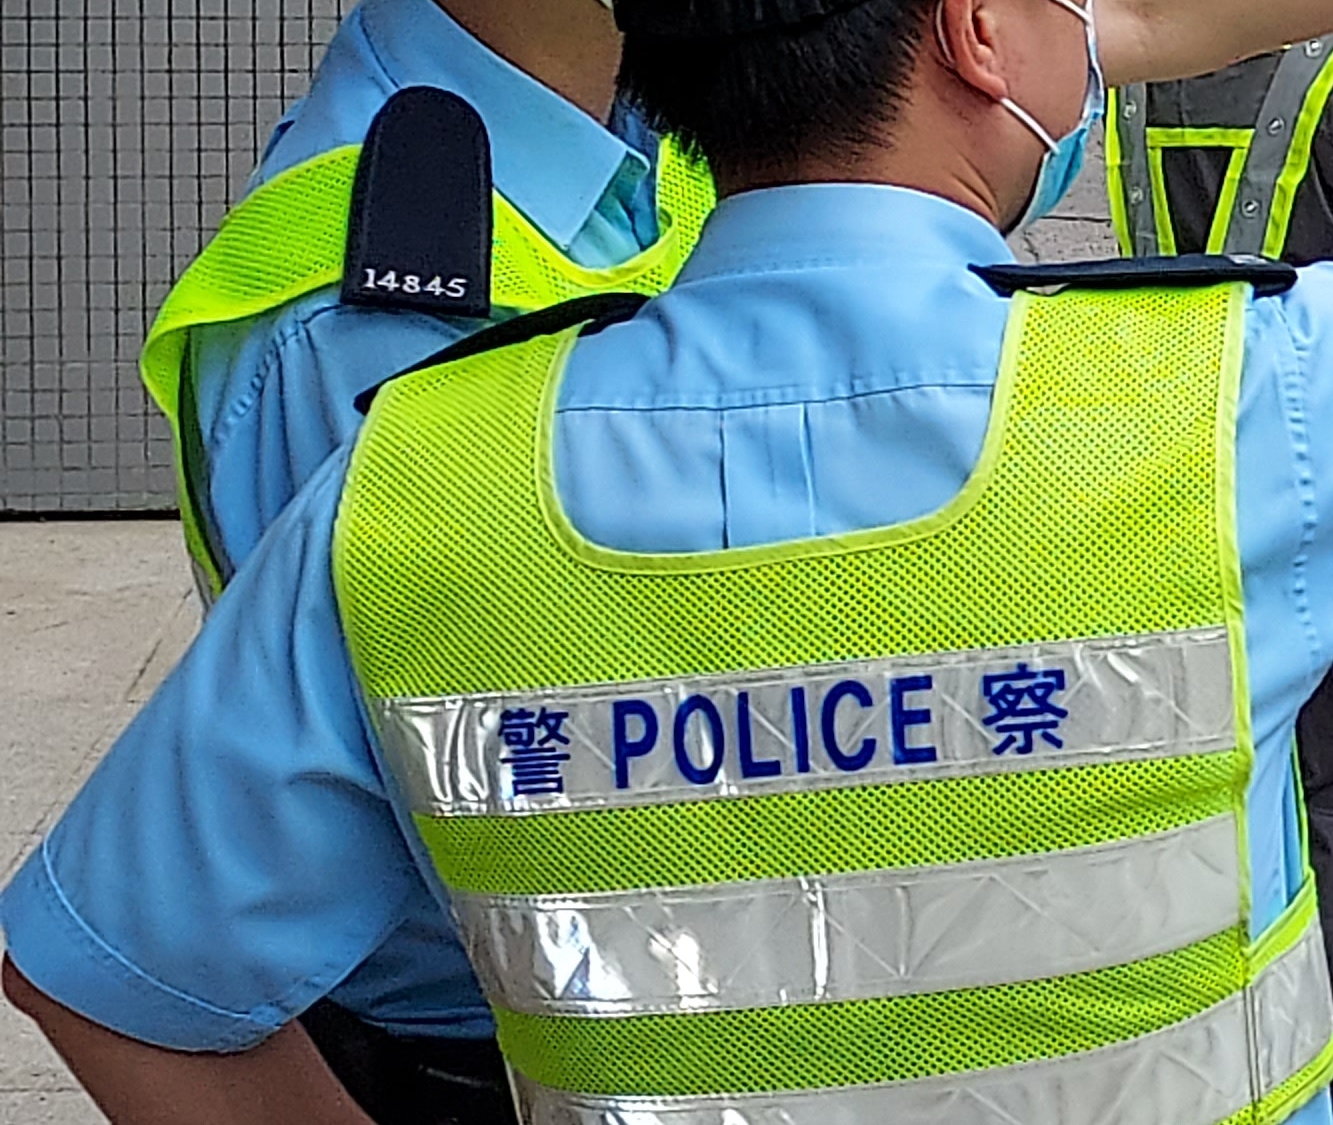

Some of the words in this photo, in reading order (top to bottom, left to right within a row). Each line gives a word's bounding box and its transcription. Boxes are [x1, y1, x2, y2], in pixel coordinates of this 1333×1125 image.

[361, 268, 468, 298] 14845
[498, 706, 571, 796] 警
[611, 675, 937, 789] POLICE
[981, 662, 1068, 756] 察
